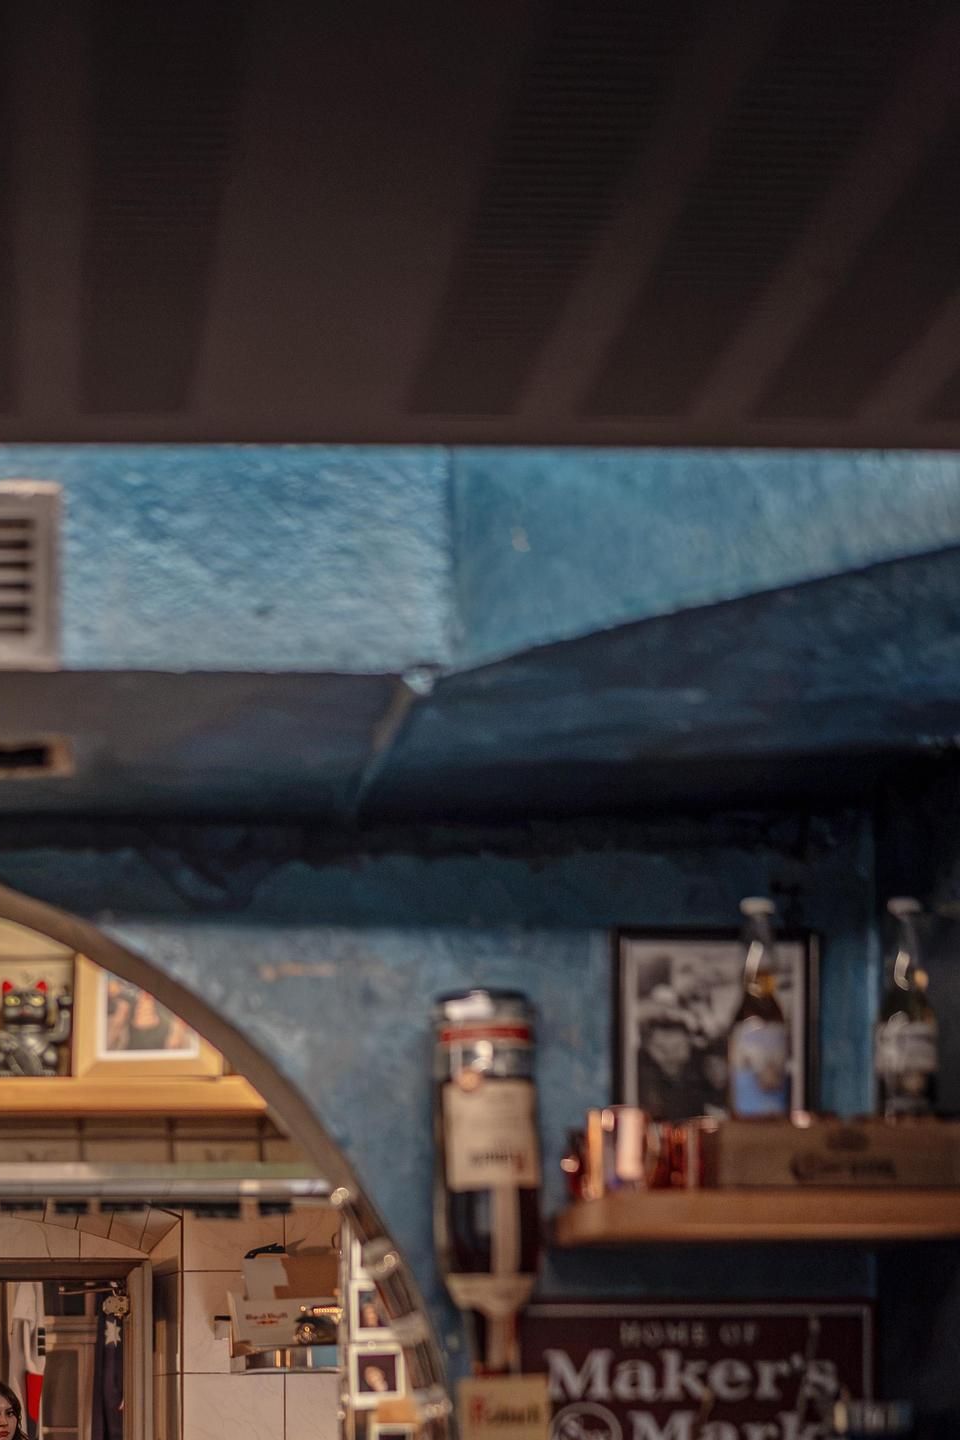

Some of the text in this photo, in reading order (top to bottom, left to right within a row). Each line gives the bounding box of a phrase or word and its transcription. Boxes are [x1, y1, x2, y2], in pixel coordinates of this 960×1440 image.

[618, 1321, 758, 1346] HOME OF
[544, 1347, 840, 1402] Maker's
